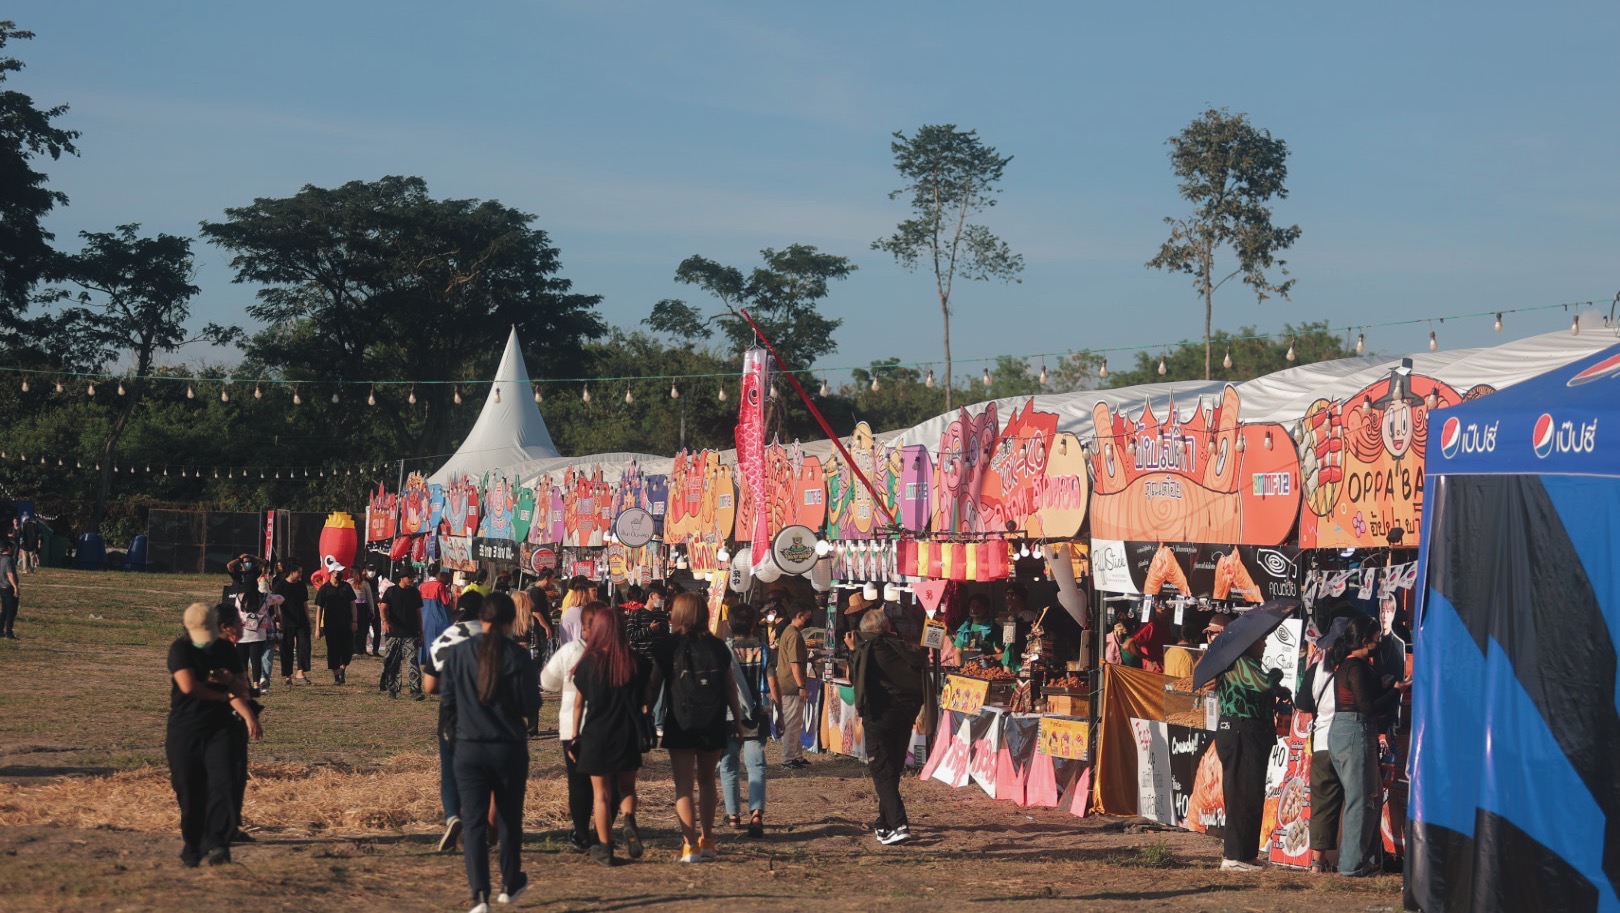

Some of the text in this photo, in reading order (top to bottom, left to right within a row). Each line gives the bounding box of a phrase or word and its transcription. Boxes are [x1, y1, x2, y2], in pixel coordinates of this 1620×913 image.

[1461, 420, 1499, 453] เป๊ปซี่
[1556, 418, 1598, 453] เป๊ปซี่
[1347, 469, 1395, 503] OPPA
[1105, 547, 1126, 571] Stick
[1272, 745, 1286, 768] 40
[1175, 792, 1189, 818] 40
